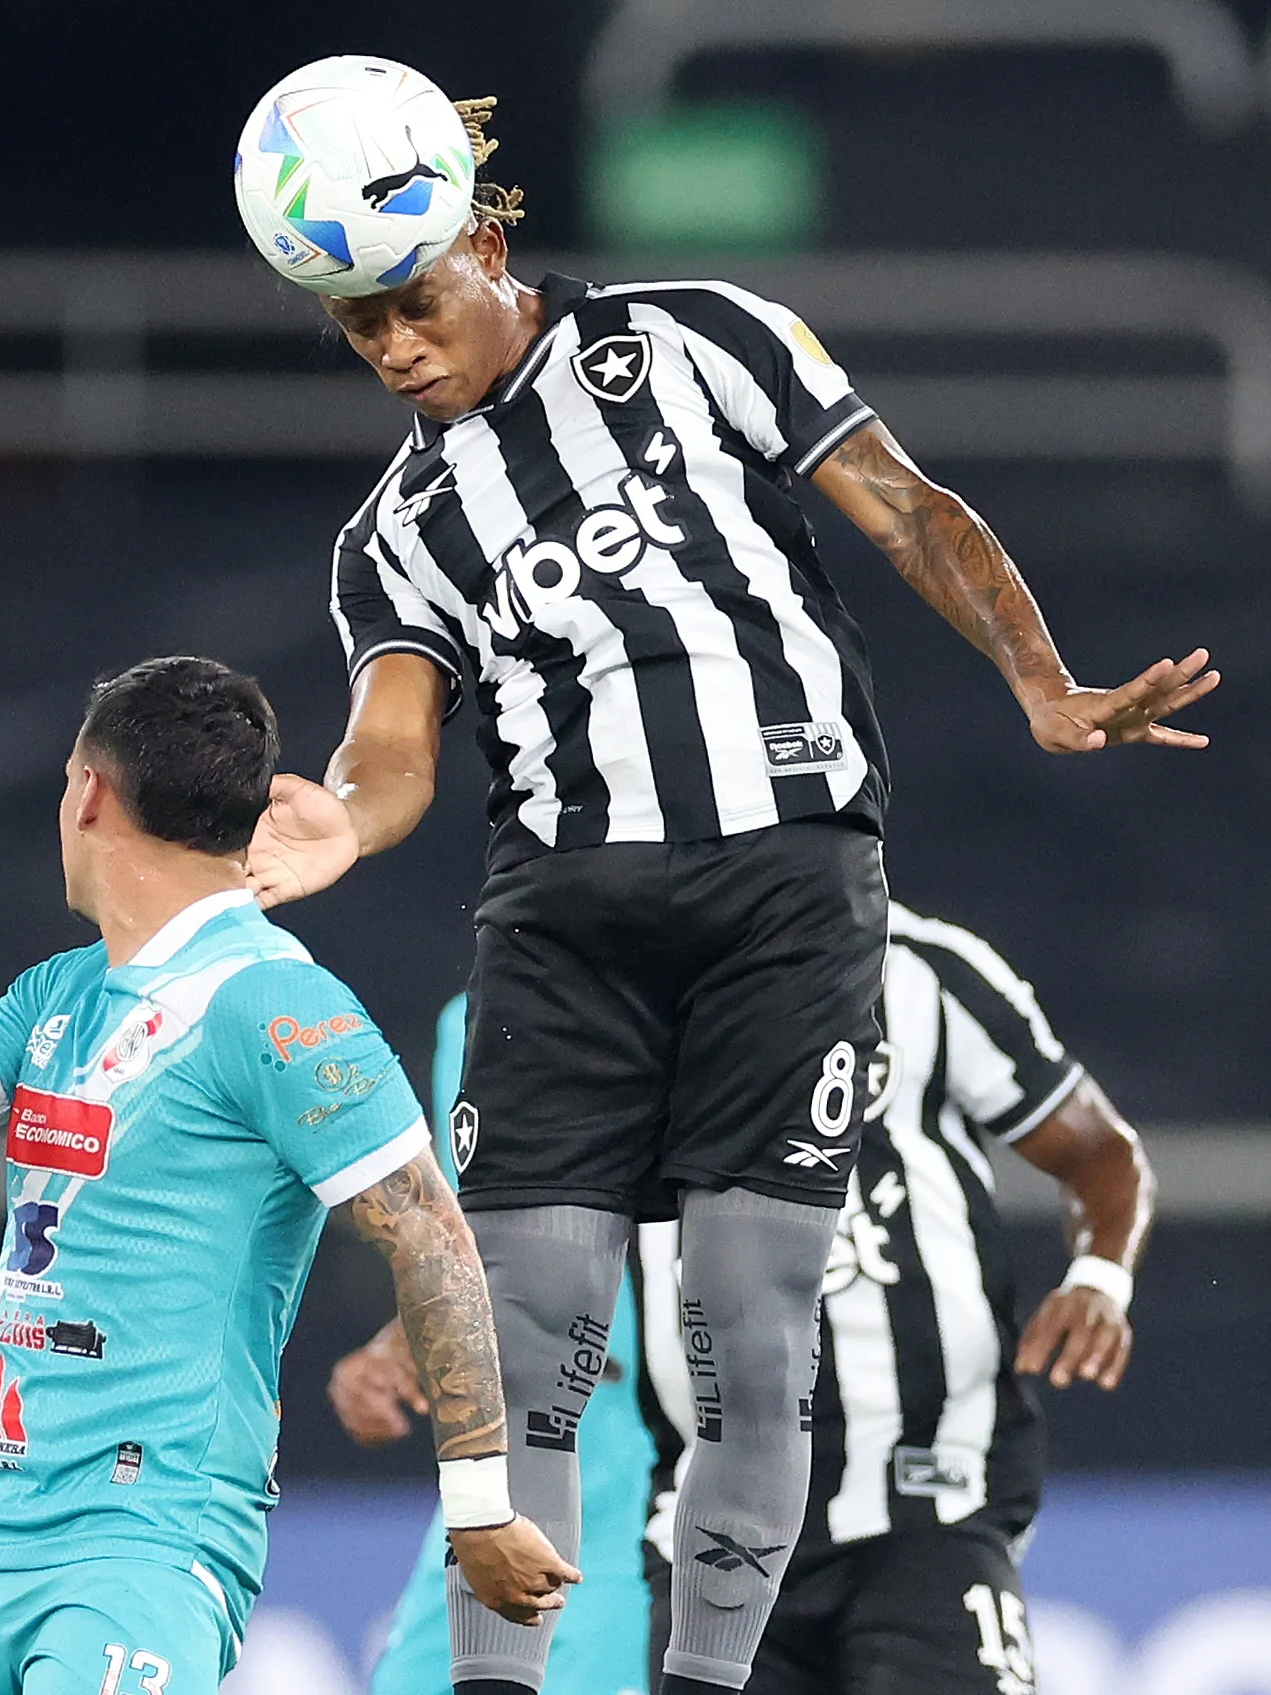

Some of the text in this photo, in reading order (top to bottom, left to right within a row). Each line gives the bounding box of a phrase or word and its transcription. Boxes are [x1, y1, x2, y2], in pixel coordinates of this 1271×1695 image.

[482, 474, 686, 641] vbet
[15, 1122, 100, 1154] ECONOMICO
[811, 1040, 856, 1138] 8
[551, 1313, 609, 1420] Lifefit
[683, 1298, 721, 1404] Lifefit
[100, 1642, 171, 1695] 13
[962, 1583, 1034, 1684] 15
